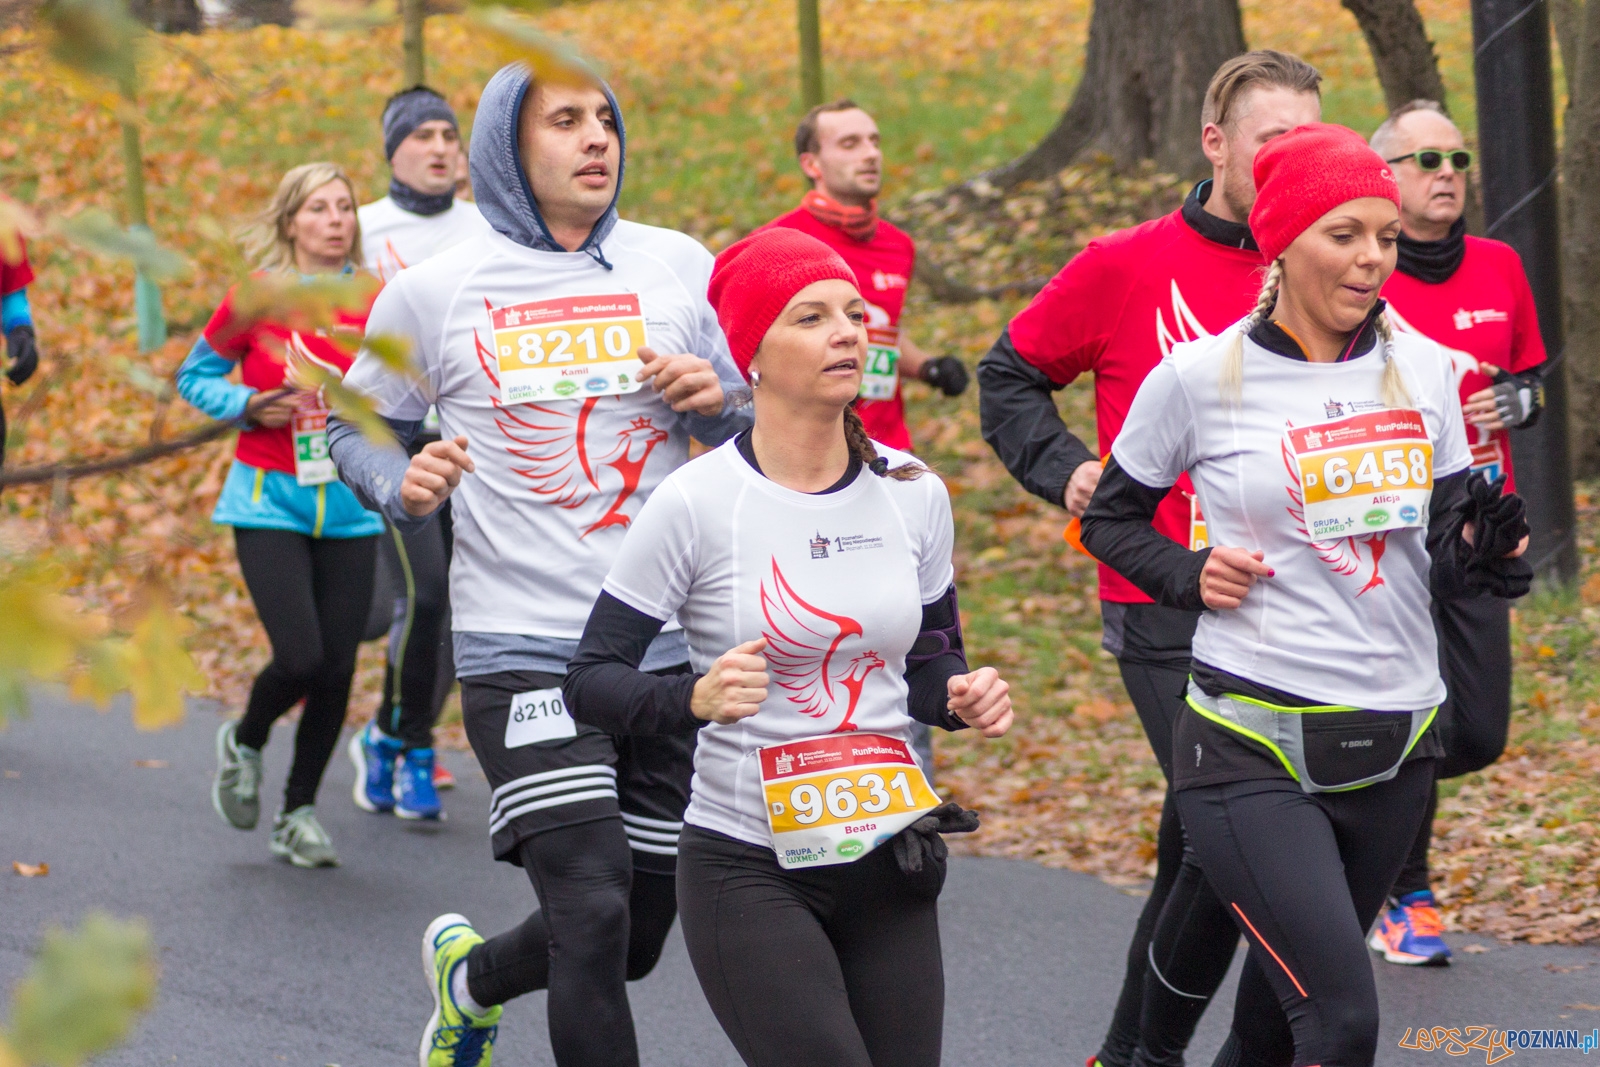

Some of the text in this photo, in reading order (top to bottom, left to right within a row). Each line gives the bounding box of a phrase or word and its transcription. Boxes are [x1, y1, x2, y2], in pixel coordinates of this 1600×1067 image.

[572, 303, 632, 313] RunPoland.org
[501, 325, 631, 365] D 8210
[561, 367, 589, 376] Kamil
[508, 385, 532, 394] GRUPA
[509, 391, 537, 400] LUXMED
[1305, 447, 1428, 494] D 6458
[1372, 495, 1401, 505] Alicja
[1313, 518, 1340, 528] GRUPA
[514, 698, 562, 723] 8210
[1348, 739, 1373, 748] BRUGI
[851, 746, 906, 759] RunPoland.org
[772, 771, 916, 825] D 9631
[844, 822, 877, 835] Beata
[785, 847, 812, 858] GRUPA
[786, 854, 818, 864] LUXMED
